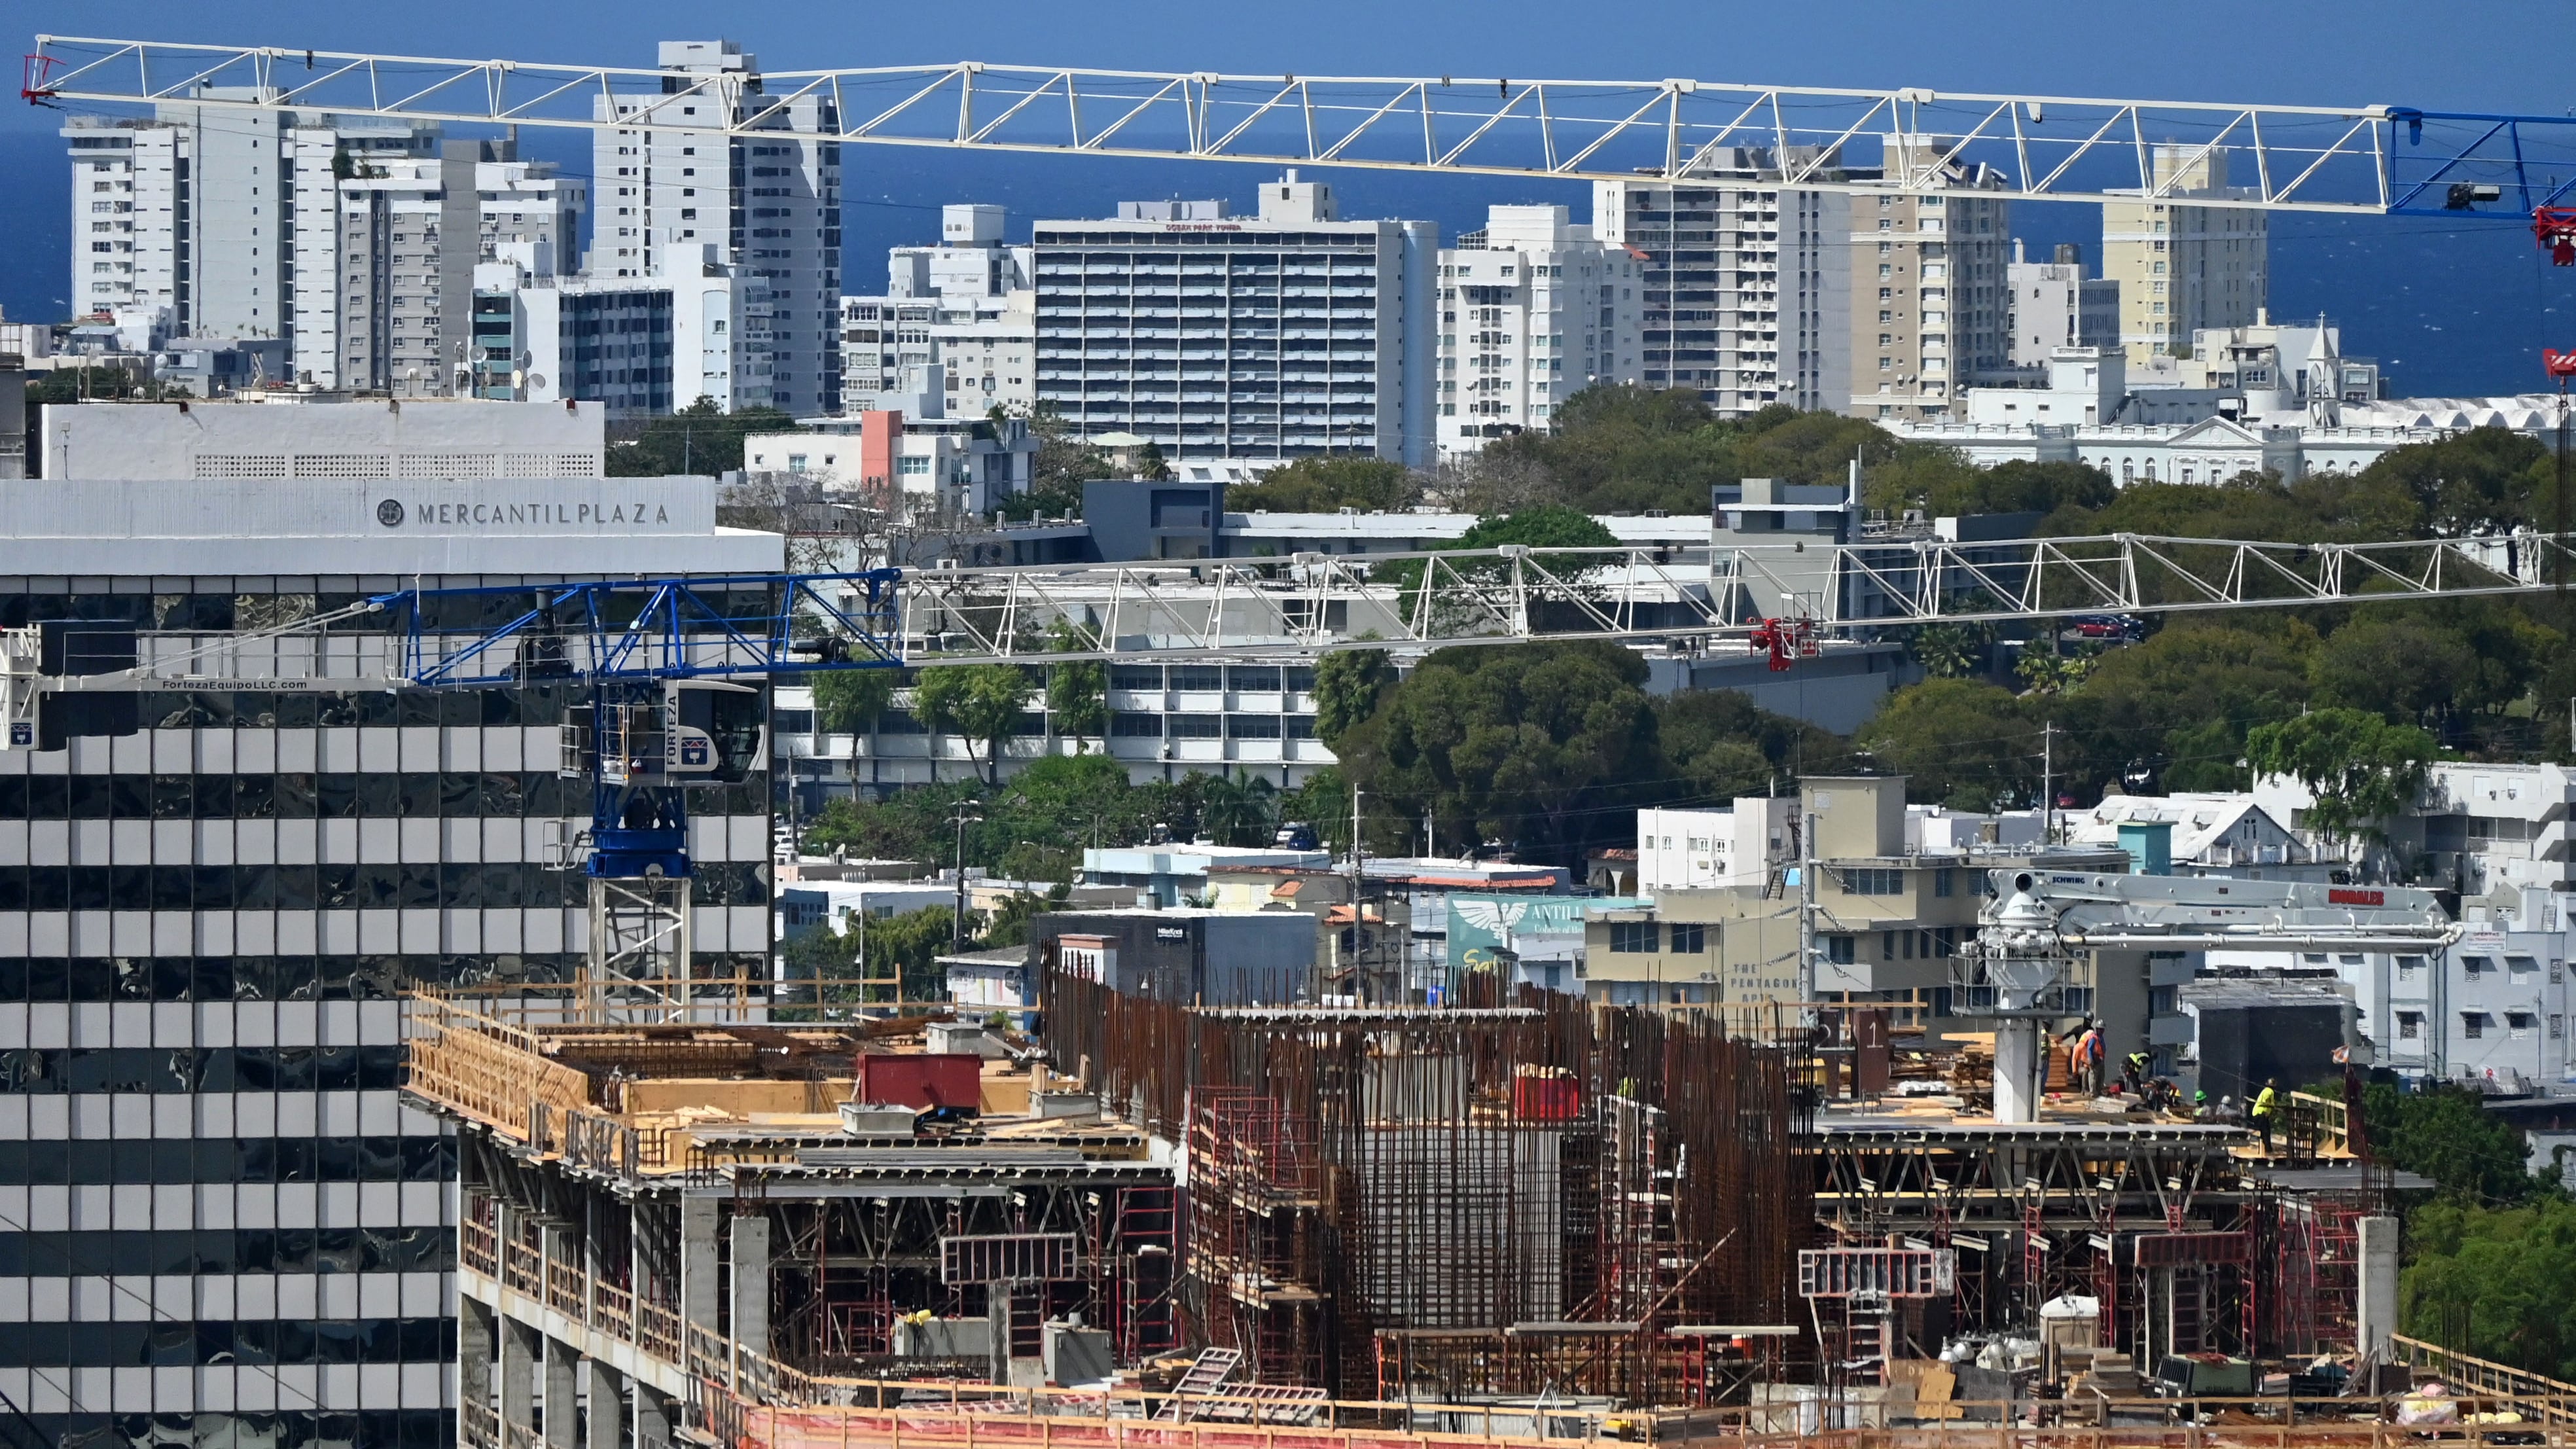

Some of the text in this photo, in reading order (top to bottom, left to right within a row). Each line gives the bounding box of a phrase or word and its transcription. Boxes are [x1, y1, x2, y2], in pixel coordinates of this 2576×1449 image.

[418, 503, 669, 524] MERCANTIL PLAZA
[162, 680, 308, 690] FortezaEquipoLLC.com
[667, 695, 677, 765] FORTEZA
[2329, 889, 2384, 906] MORALES
[1734, 963, 1756, 974] THE
[1730, 978, 1797, 988] PENTAGON
[1867, 1022, 1884, 1048] 1
